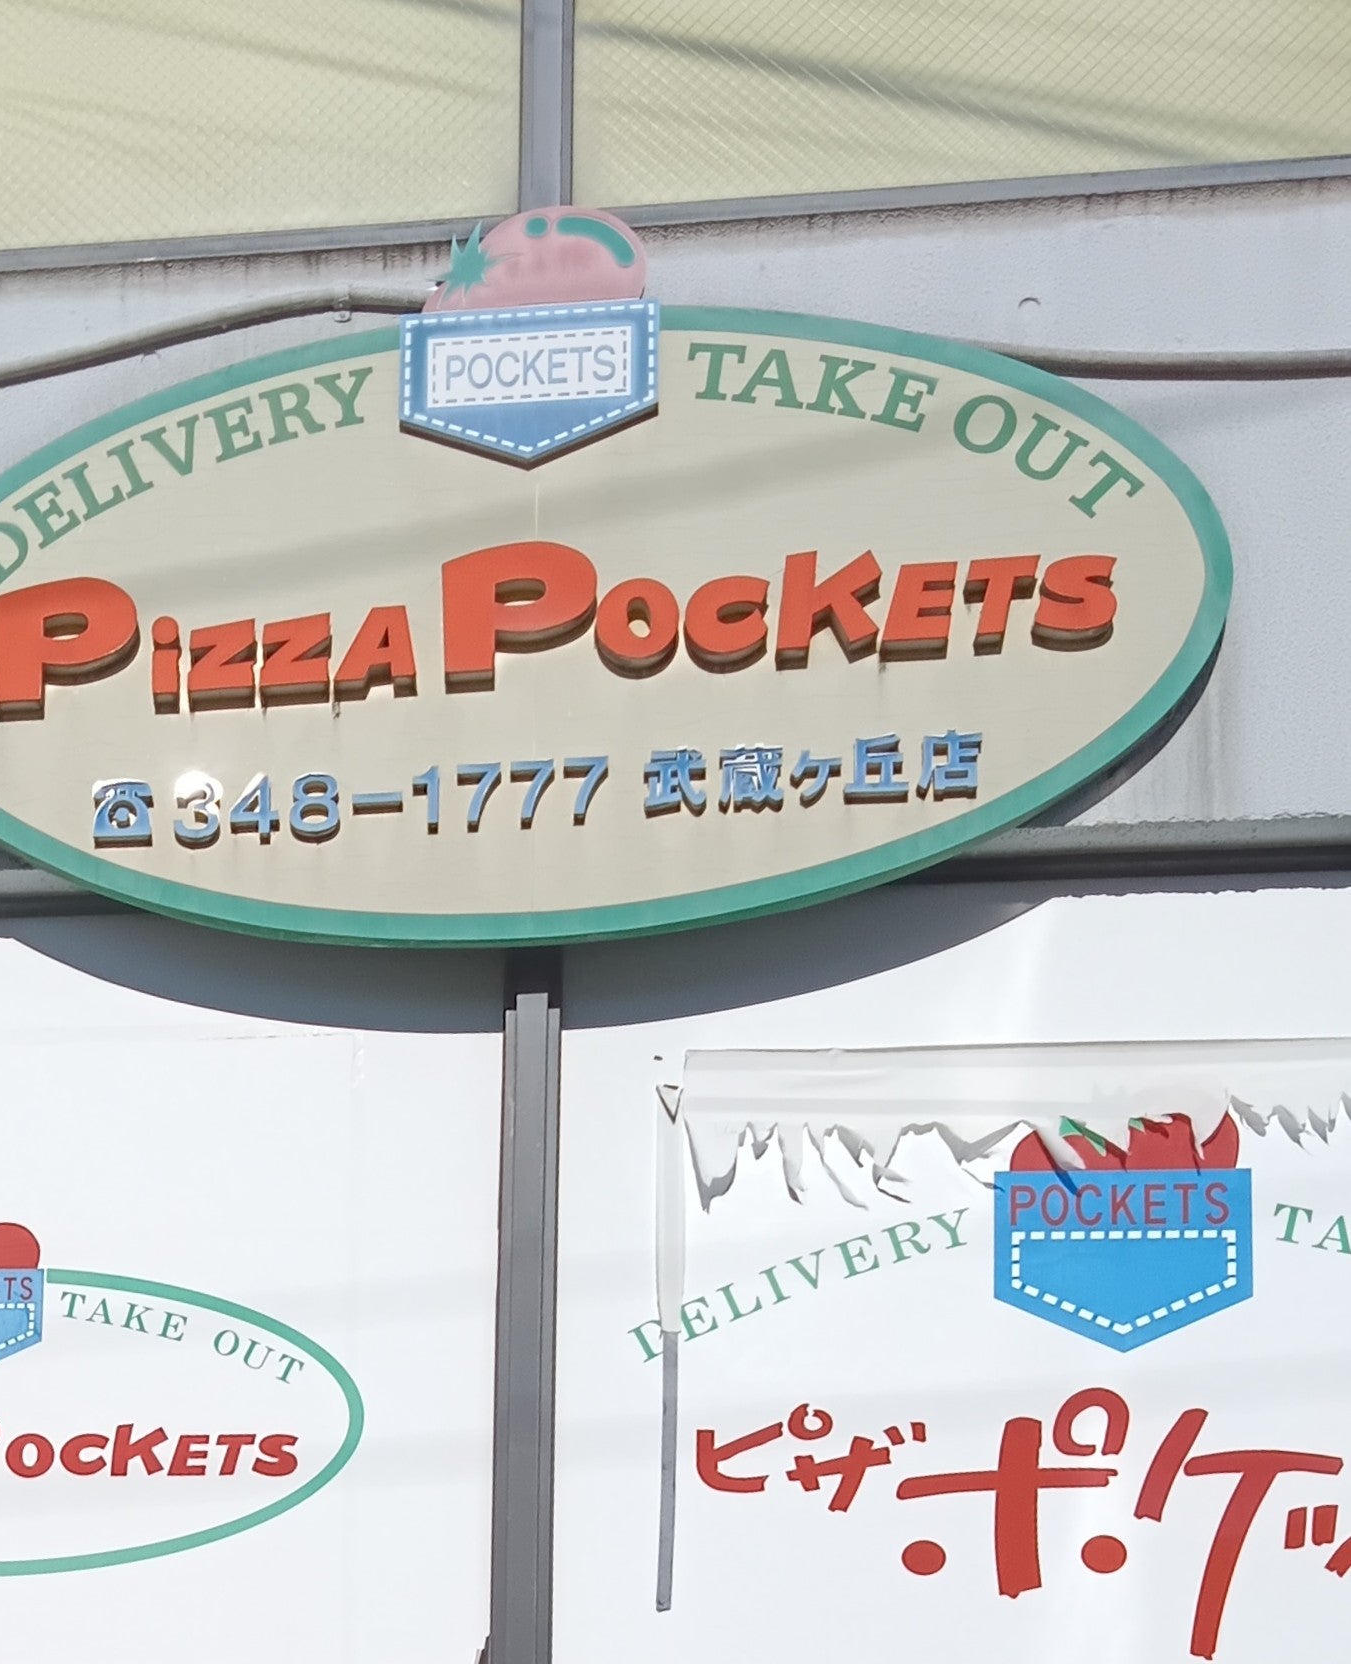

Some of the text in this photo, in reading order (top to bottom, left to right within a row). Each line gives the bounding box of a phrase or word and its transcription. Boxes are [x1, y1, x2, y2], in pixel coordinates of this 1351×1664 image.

[444, 343, 618, 392] POCKETS
[686, 341, 1145, 520] TAKE OUT
[1008, 1180, 1231, 1227] POCKETS
[60, 1290, 307, 1386] TAKE OUT
